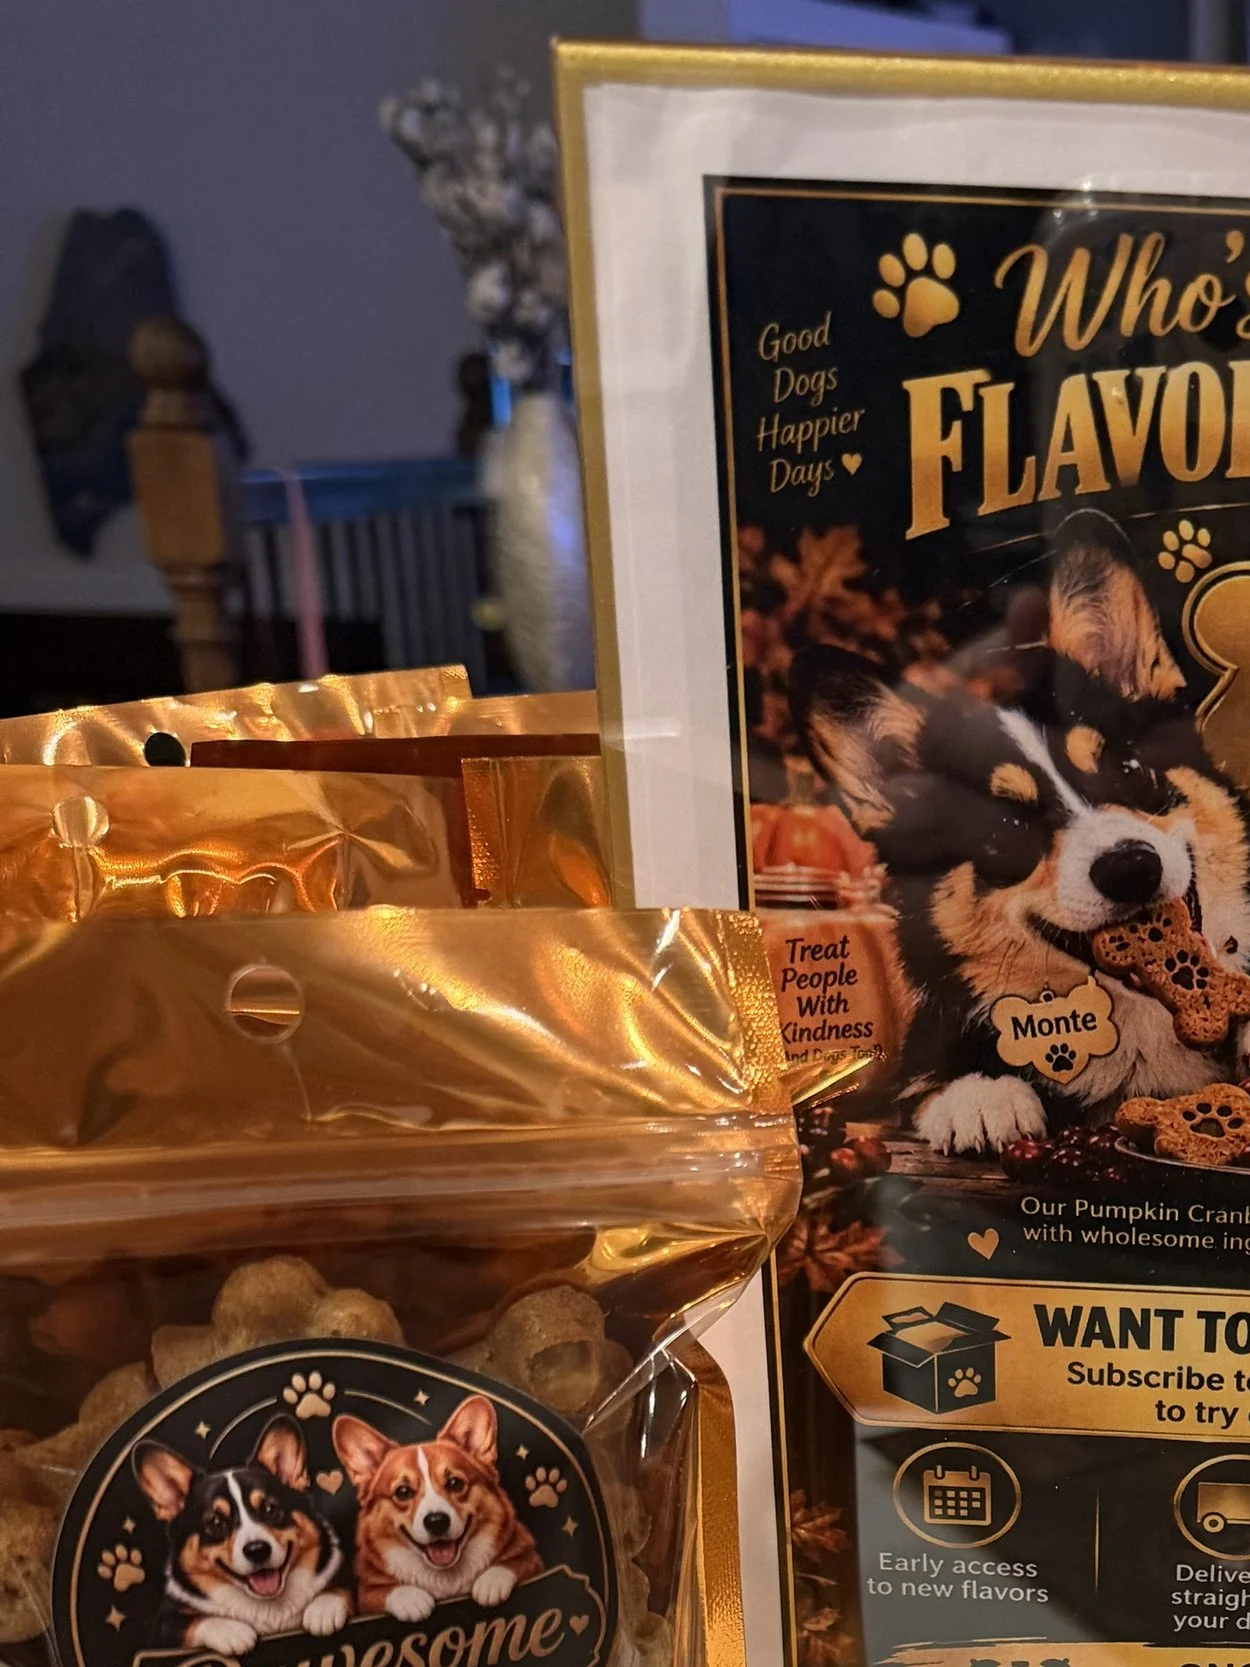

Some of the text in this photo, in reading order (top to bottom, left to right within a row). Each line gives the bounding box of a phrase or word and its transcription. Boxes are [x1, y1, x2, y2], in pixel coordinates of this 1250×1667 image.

[759, 310, 831, 363] Good
[774, 367, 838, 406] Dogs
[757, 407, 866, 454] Happier
[770, 458, 835, 497] Days
[785, 935, 850, 964] Treat
[781, 962, 858, 993] People
[796, 992, 849, 1018] With
[1011, 1009, 1097, 1040] Monte
[1021, 1196, 1067, 1217] Our
[1075, 1199, 1179, 1224] Pumpkin
[1023, 1224, 1072, 1244] with
[1081, 1227, 1214, 1249] wholesome
[1033, 1304, 1183, 1352] WANT
[1067, 1361, 1224, 1391] Subscribe
[1155, 1399, 1186, 1422] to
[1195, 1401, 1240, 1430] try
[878, 1552, 1038, 1578] Early access
[866, 1576, 1049, 1604] to new flavors
[1173, 1614, 1230, 1634] your
